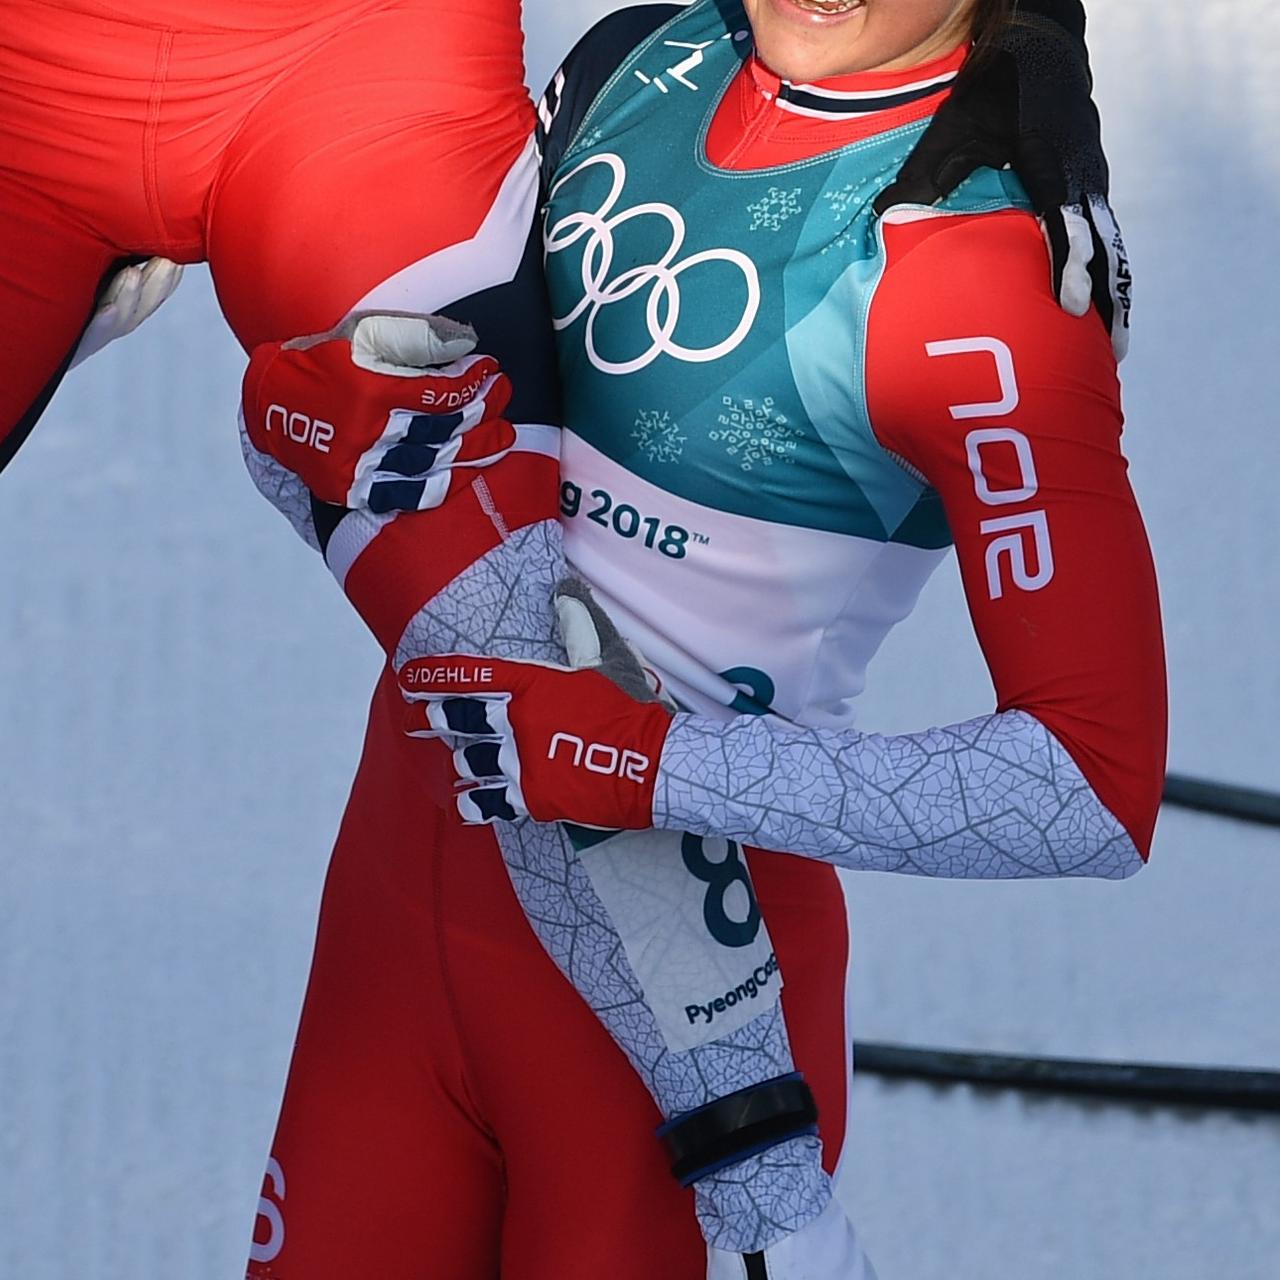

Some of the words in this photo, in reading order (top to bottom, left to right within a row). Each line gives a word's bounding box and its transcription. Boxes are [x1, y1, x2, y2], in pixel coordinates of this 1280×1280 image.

[266, 404, 335, 454] NOR
[925, 336, 1055, 600] NOR
[547, 732, 649, 784] NOR
